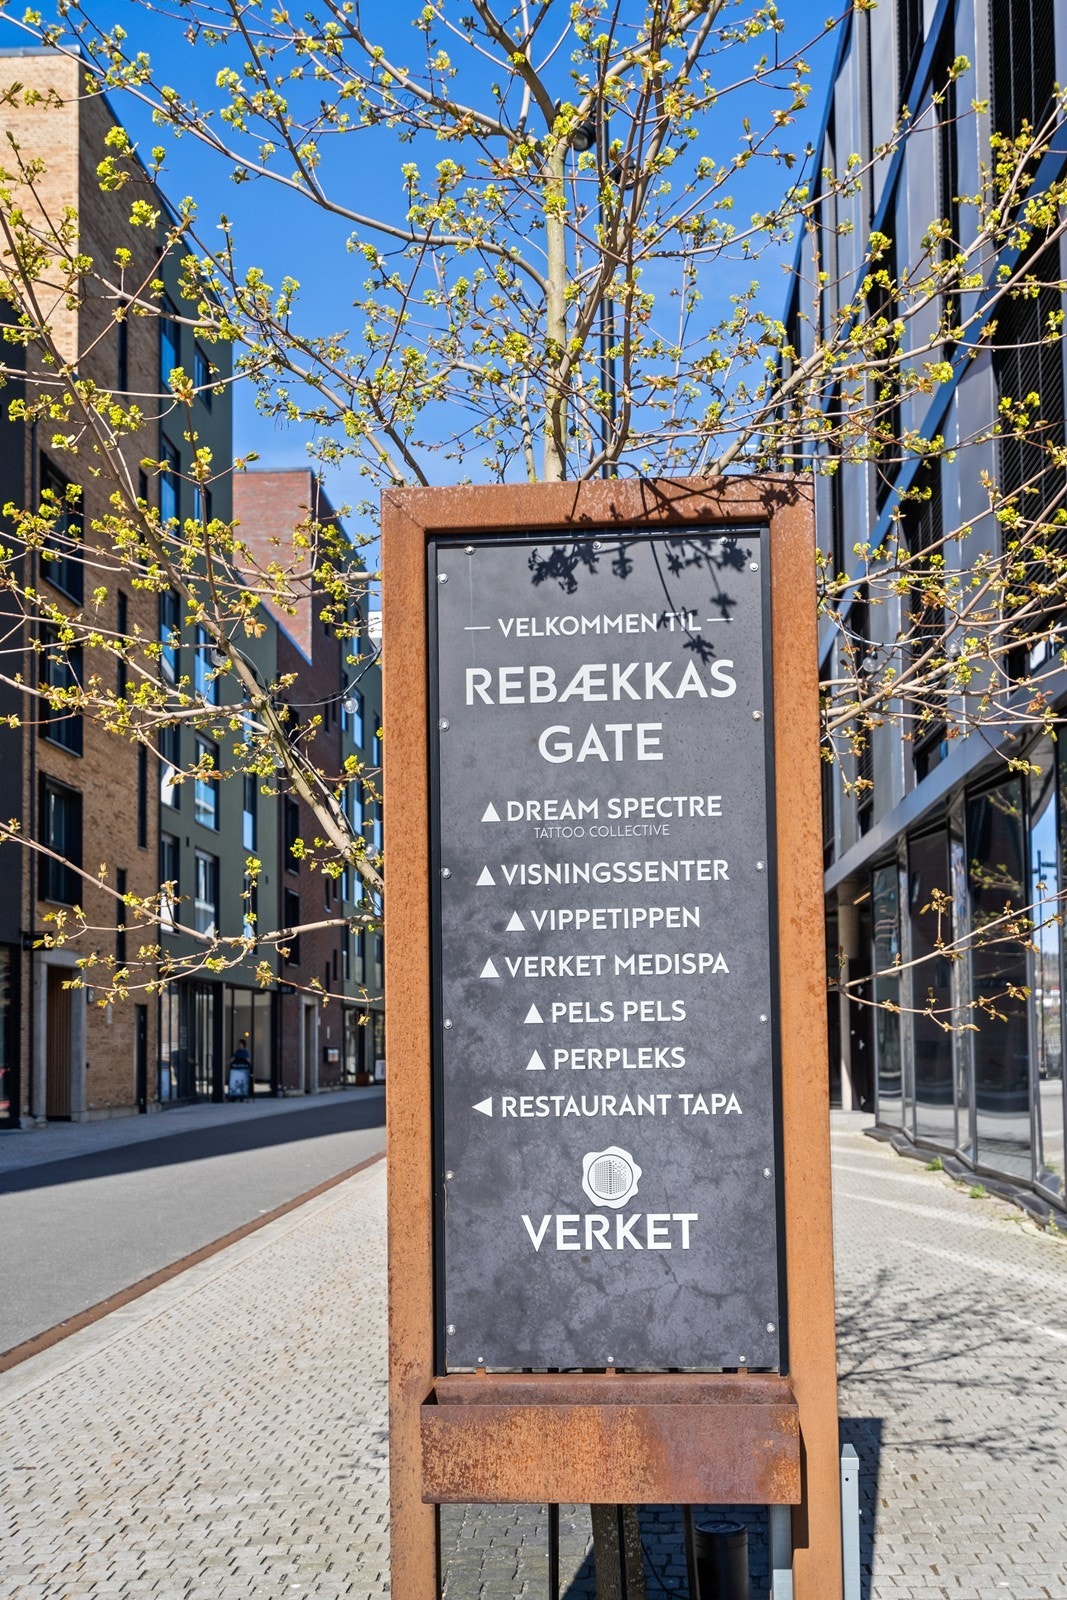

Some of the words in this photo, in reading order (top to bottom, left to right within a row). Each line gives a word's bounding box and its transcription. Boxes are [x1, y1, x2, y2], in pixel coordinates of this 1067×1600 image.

[497, 613, 658, 638] VELKOMMEN
[664, 611, 702, 632] TIL
[465, 658, 738, 706] REBÆKKAS
[537, 722, 664, 764] GATE
[507, 797, 600, 822] DREAM
[606, 795, 723, 820] SPECTRE
[533, 826, 585, 840] TATTOO
[588, 824, 670, 839] COLLECTIVE
[500, 859, 730, 886] VISNINGSSENTER
[530, 906, 701, 932] VIPPETIPPEN
[504, 954, 606, 978] VERKET
[614, 952, 731, 976] MEDISPA
[550, 1001, 615, 1024] PELS
[622, 1000, 687, 1022] PELS
[553, 1047, 686, 1070] PERPLEKS
[501, 1093, 672, 1118] RESTAURANT
[678, 1092, 743, 1116] TAPA
[520, 1213, 699, 1252] VERKET
